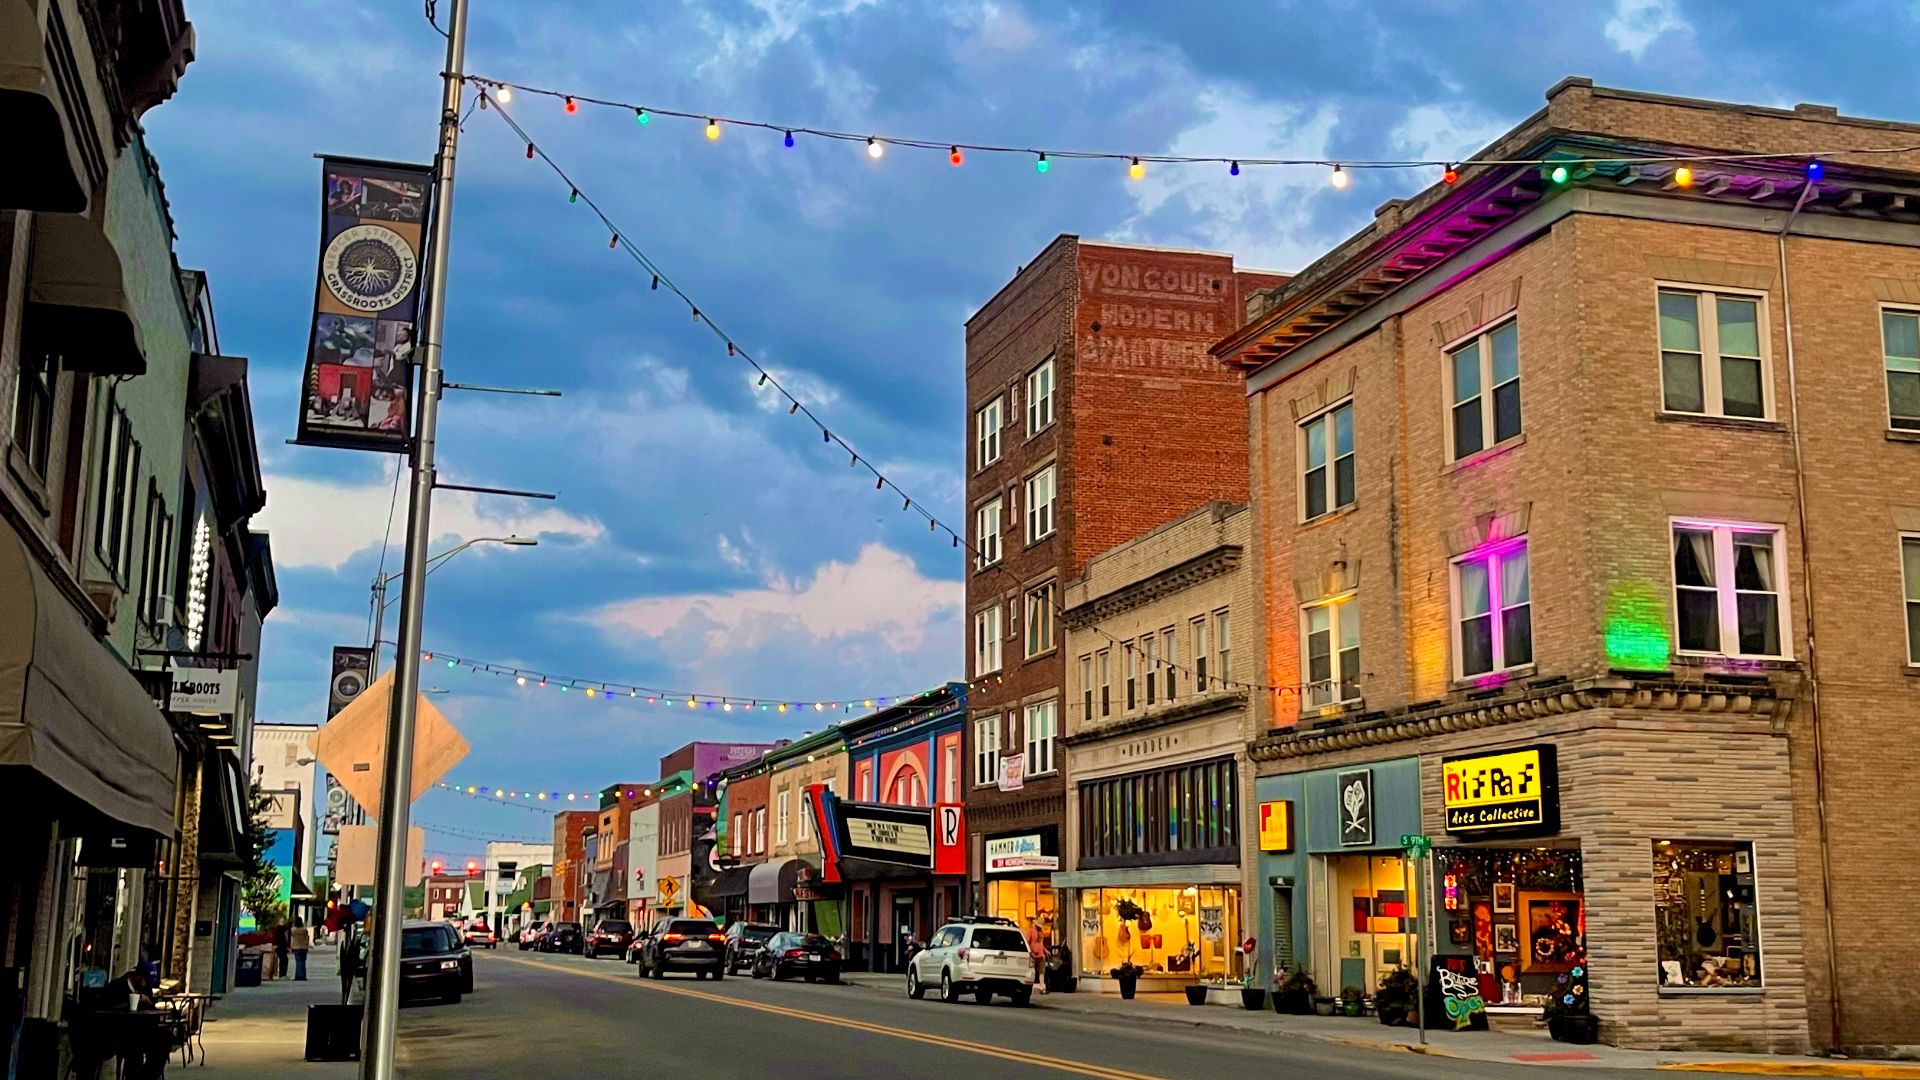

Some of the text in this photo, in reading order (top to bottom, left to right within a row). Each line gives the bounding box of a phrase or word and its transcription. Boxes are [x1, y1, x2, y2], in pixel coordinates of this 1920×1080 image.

[327, 228, 408, 268] MERCER STREET
[327, 257, 413, 308] GRASSROOTS DISTRICT
[1101, 303, 1214, 333] MODERN
[944, 808, 957, 844] R
[1452, 807, 1534, 825] Arts Collective
[990, 840, 1014, 855] HAMMER
[1402, 835, 1408, 845] S
[1410, 836, 1424, 846] 9TH
